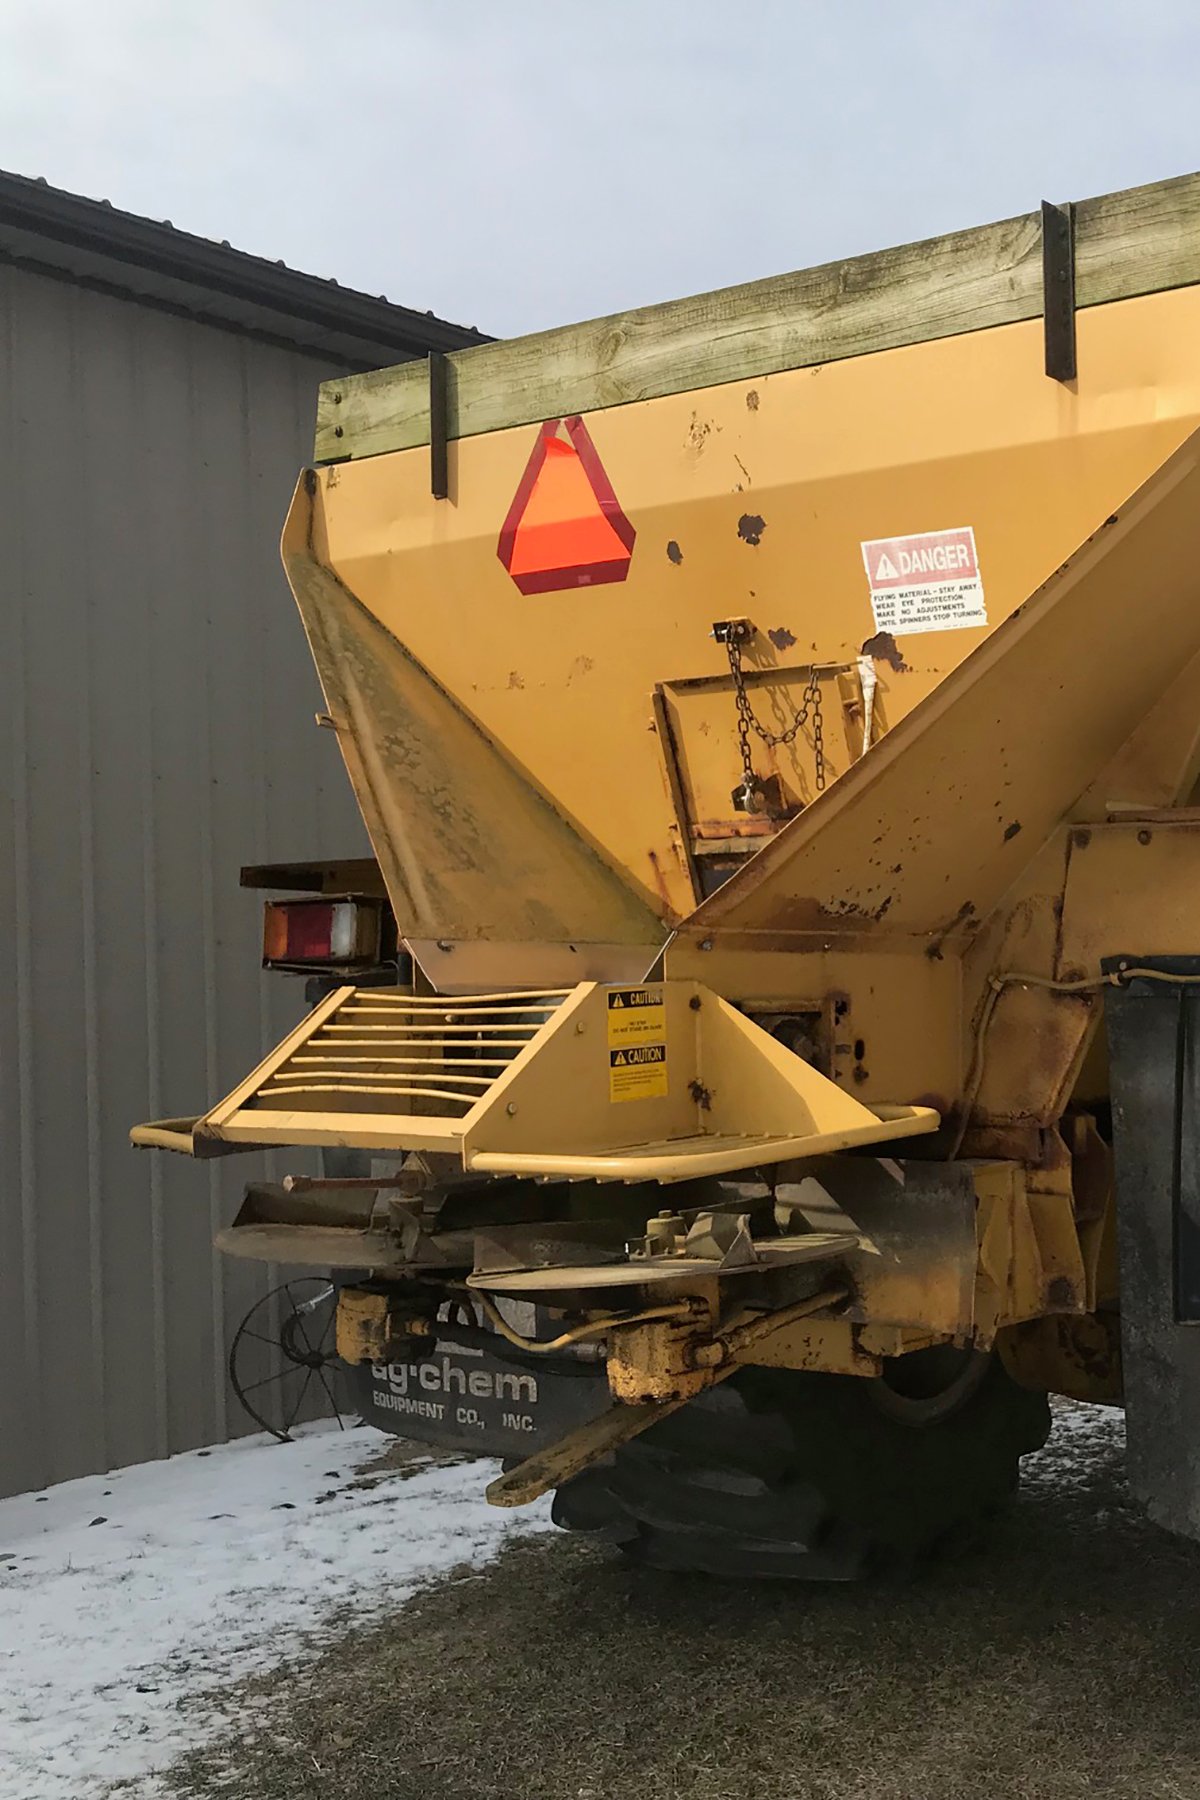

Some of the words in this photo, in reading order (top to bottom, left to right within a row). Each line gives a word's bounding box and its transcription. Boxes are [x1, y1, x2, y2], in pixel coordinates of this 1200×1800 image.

[899, 543, 970, 575] DANGER
[874, 593, 896, 602] FLYING
[899, 589, 932, 599] MATERIAL
[939, 586, 955, 595] STAY
[876, 602, 895, 610] WEAR
[902, 599, 914, 607] EYE
[876, 610, 895, 619] MAKE
[901, 608, 911, 616] NO
[916, 603, 965, 615] ADJUSTMENTS
[878, 618, 897, 627] UNTIL
[899, 615, 932, 625] SPINNERS
[933, 612, 951, 622] STOP
[628, 1047, 662, 1064] CAUTION
[372, 1390, 444, 1420] EQUIPMENT
[456, 1407, 485, 1430] CO.,
[502, 1412, 538, 1432] INC.
